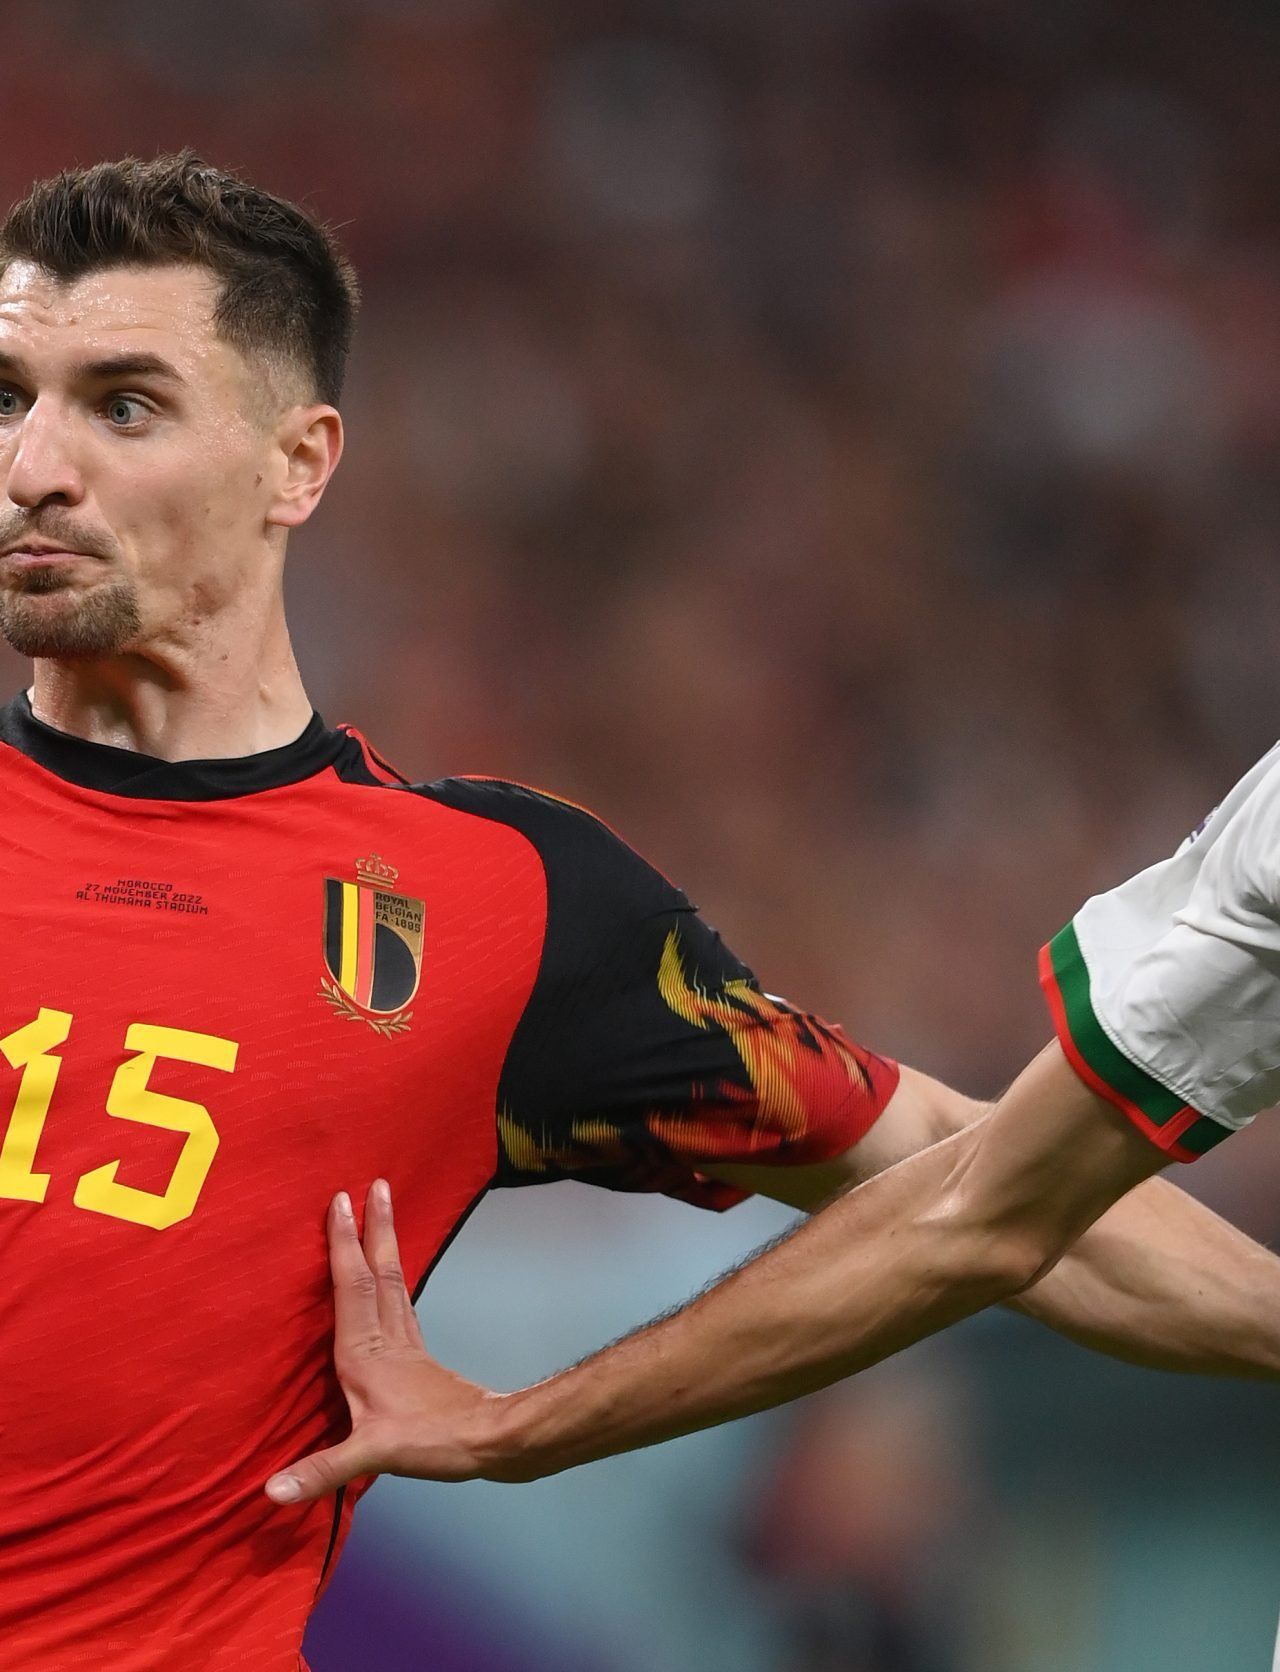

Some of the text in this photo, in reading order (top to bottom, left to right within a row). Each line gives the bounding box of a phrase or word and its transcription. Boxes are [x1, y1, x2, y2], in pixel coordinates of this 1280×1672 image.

[85, 883, 202, 904] 27 NOVEMBER 2022
[117, 879, 173, 893] MOROCCO
[76, 891, 208, 914] AL THUMAMA STADIUM
[375, 892, 409, 909] ROYAL
[375, 901, 422, 922] BELGIAN
